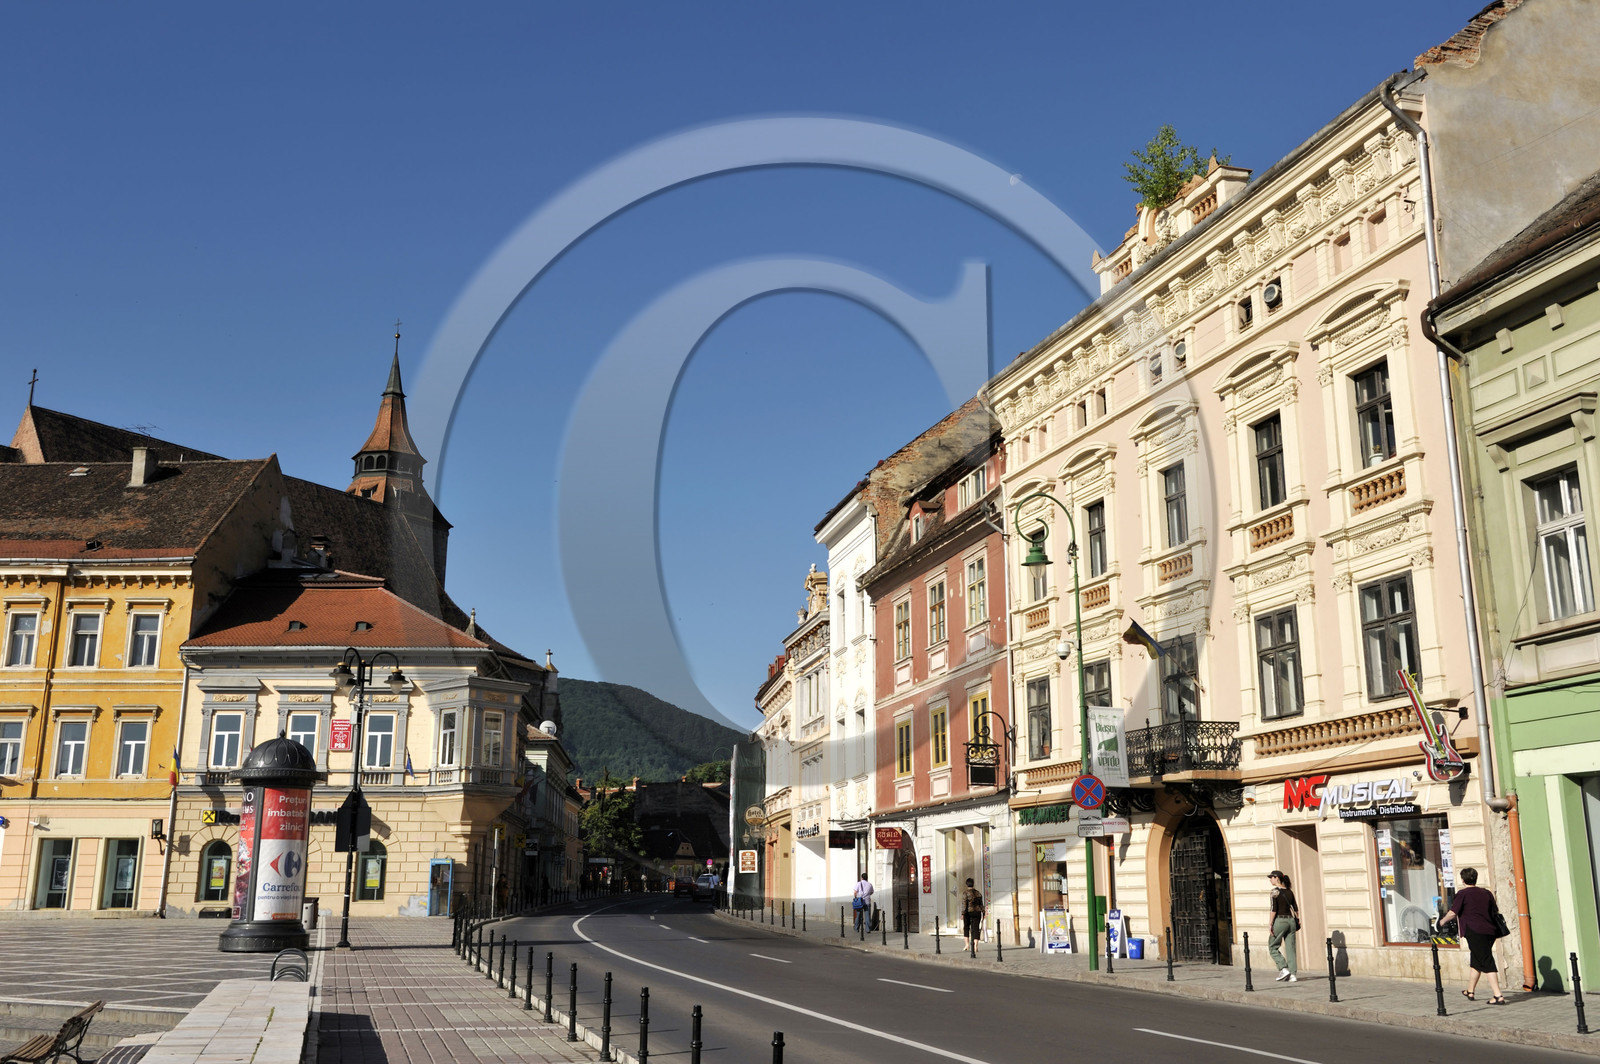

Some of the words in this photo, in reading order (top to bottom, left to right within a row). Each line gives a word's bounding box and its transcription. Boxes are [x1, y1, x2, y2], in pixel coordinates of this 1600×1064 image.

[1097, 755, 1120, 767] verde
[1318, 777, 1414, 818] MUSICAL
[1019, 804, 1070, 826] SUPERMARKET
[1339, 808, 1377, 818] Instruments
[1379, 805, 1415, 815] Distributor
